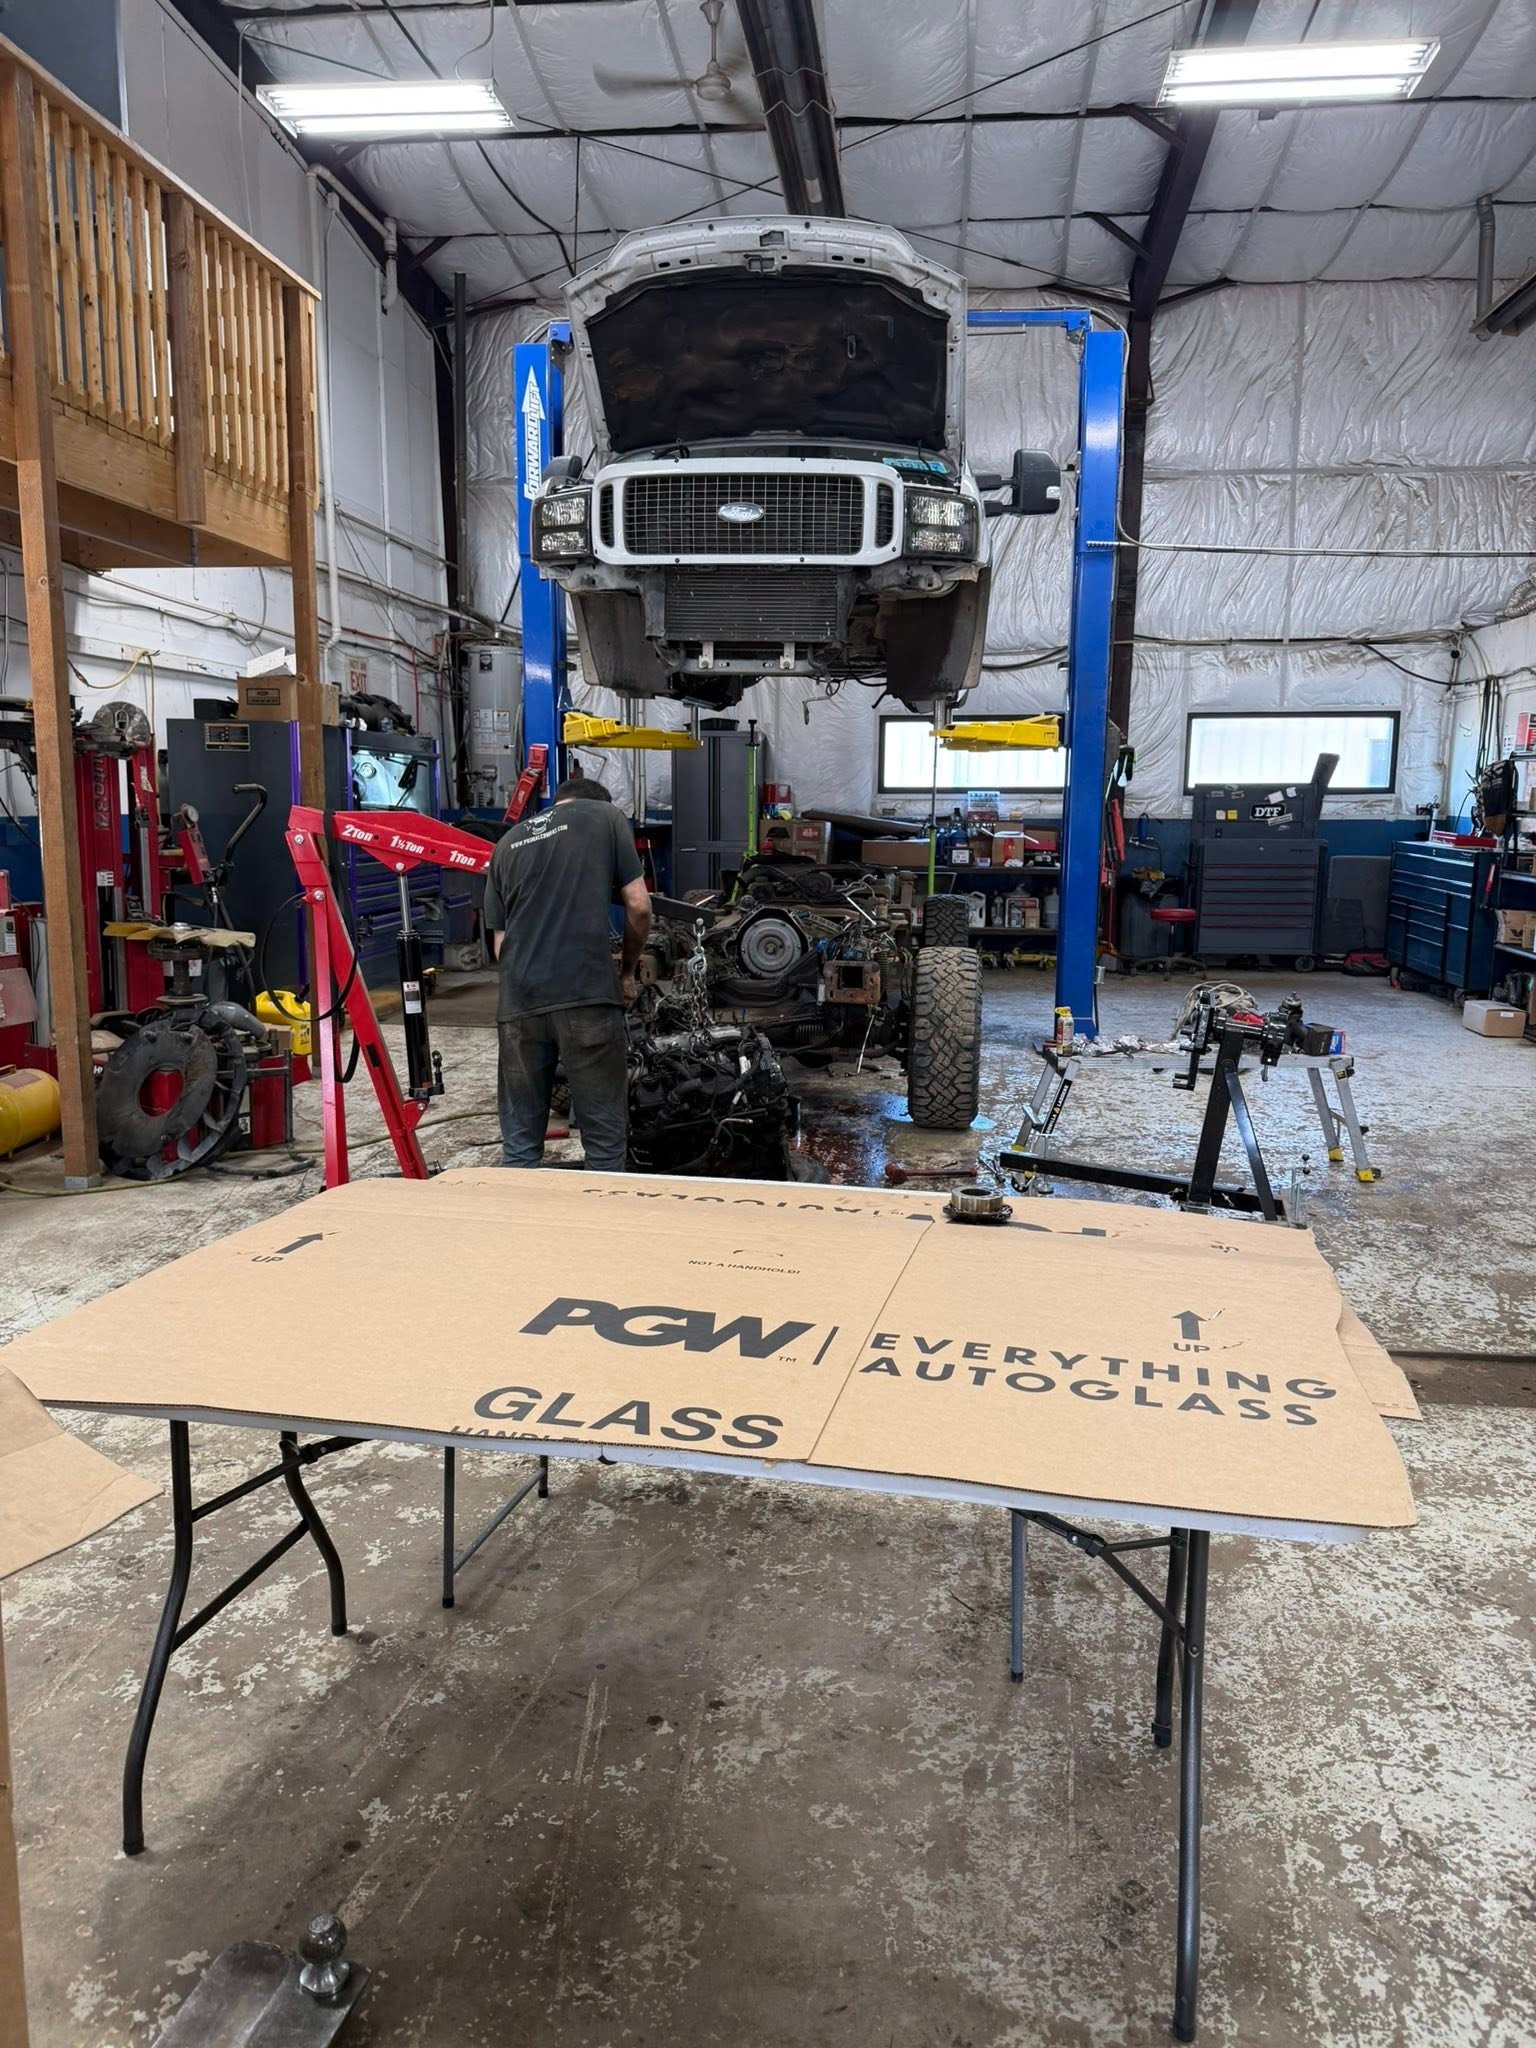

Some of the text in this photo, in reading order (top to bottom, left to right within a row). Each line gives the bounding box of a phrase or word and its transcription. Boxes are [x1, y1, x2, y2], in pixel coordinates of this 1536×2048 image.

[1254, 806, 1282, 817] DTF
[251, 1255, 284, 1263] UP
[518, 1297, 817, 1359] PGW
[1172, 1342, 1211, 1353] UP
[858, 1356, 1318, 1426] AUTOGLASS
[870, 1332, 1337, 1399] EVERYTHING
[474, 1386, 784, 1449] GLASS
